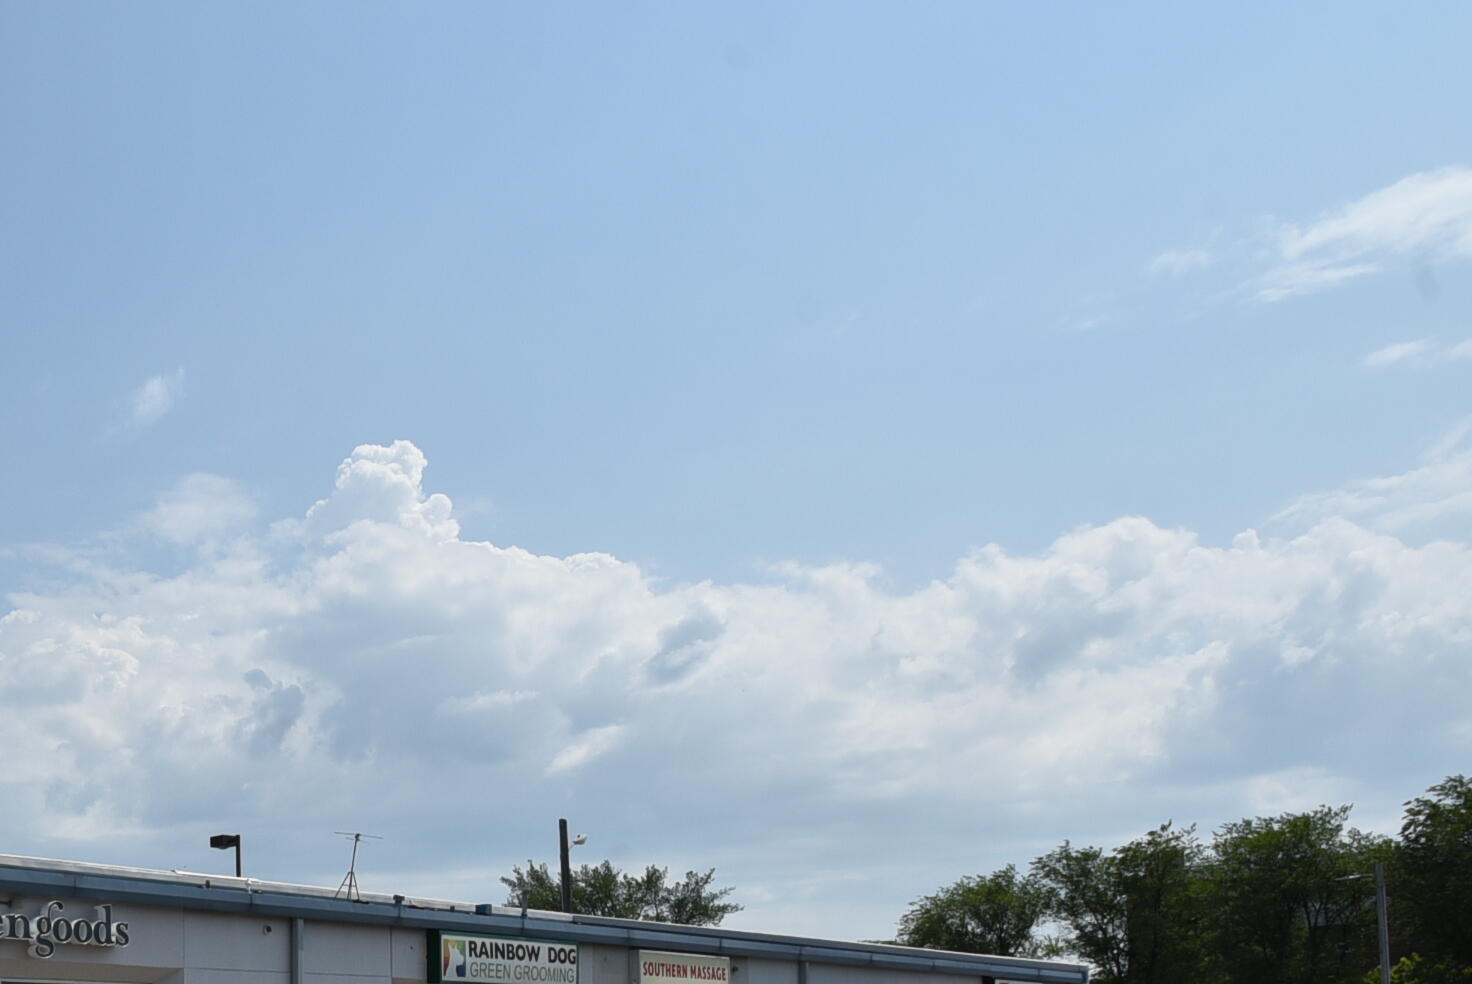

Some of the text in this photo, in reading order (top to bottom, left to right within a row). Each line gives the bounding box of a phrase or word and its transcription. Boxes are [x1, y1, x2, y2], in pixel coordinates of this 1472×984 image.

[468, 940, 576, 965] RAINBOW DOG
[470, 962, 575, 983] GREEN GROOMING
[643, 961, 726, 981] SOUTHERN MASSAGE
